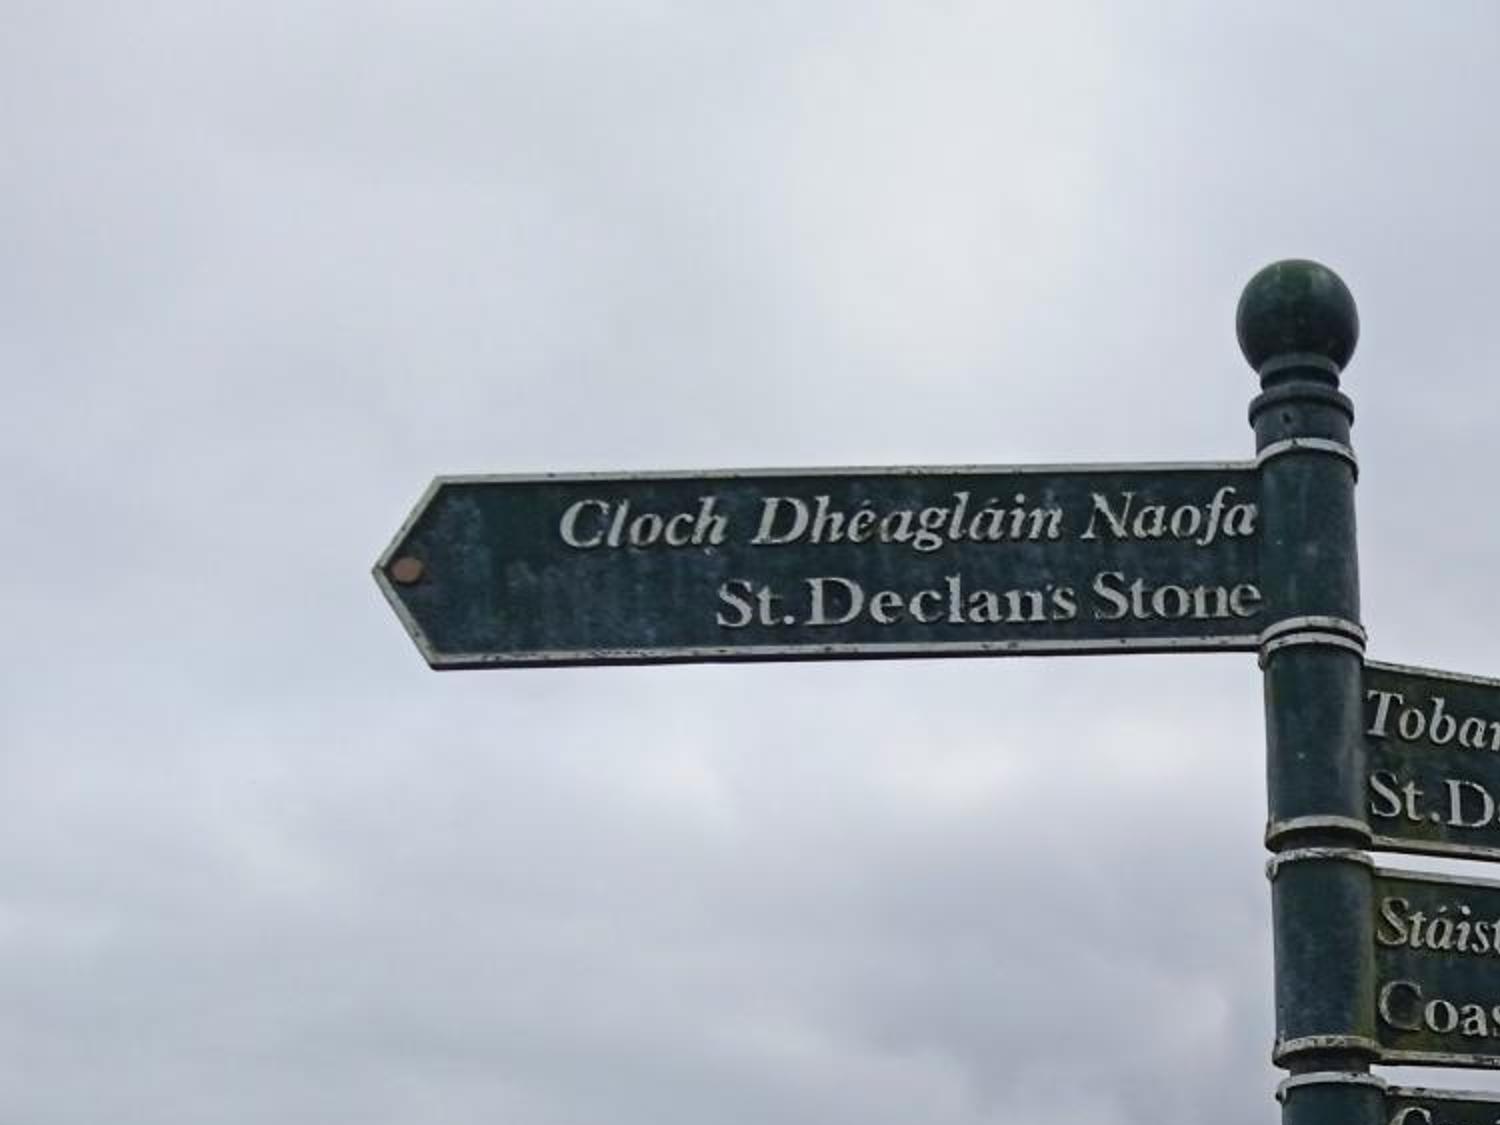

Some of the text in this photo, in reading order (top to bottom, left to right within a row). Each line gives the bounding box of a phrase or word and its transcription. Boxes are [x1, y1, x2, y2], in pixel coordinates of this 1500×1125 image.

[559, 485, 1257, 551] Cloch Dhéagláin Naofa
[1092, 570, 1263, 621] Stone
